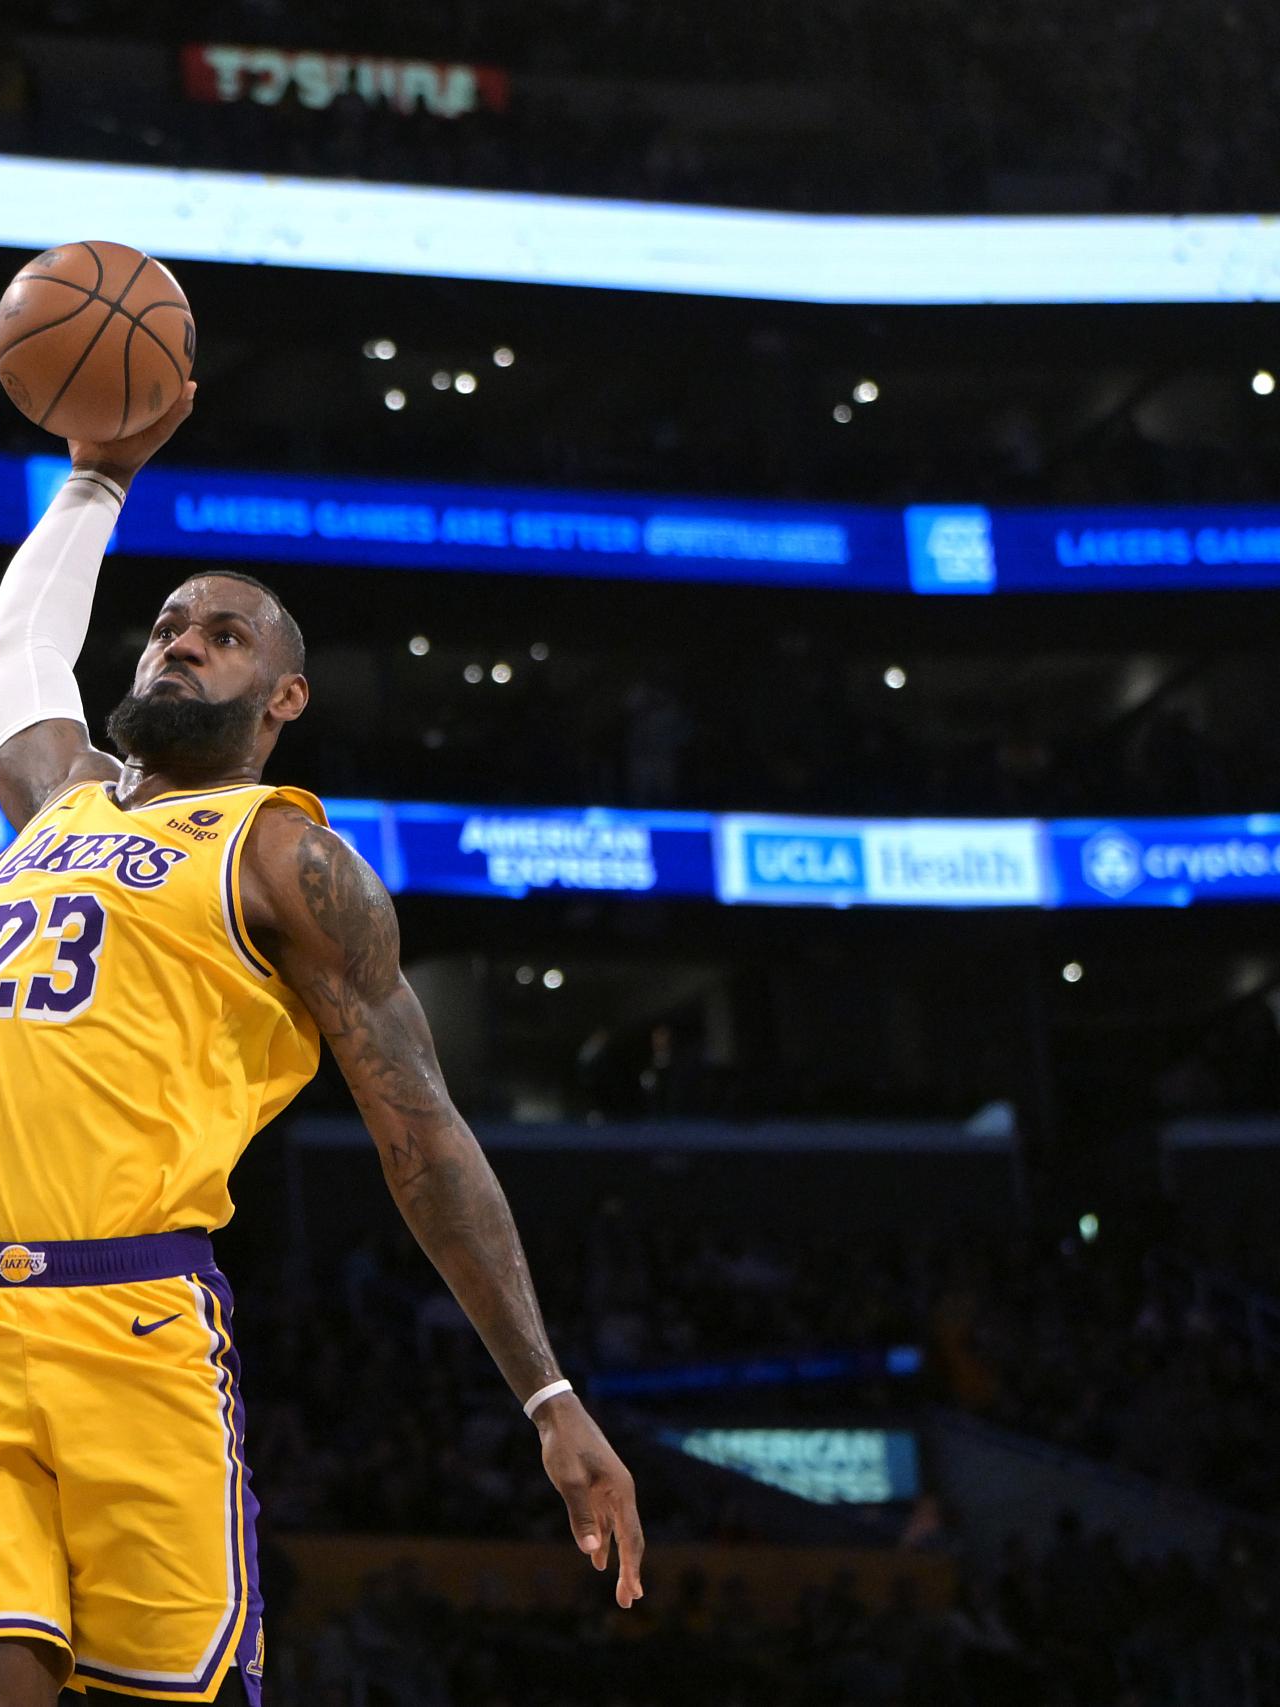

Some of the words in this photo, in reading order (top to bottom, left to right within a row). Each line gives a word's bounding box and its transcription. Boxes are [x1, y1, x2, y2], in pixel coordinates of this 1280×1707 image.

[166, 818, 219, 841] bibigo
[460, 816, 653, 855] AMERICAN
[488, 855, 657, 890] EXPRESS
[753, 842, 858, 882] UCLA
[878, 842, 1022, 886] Health
